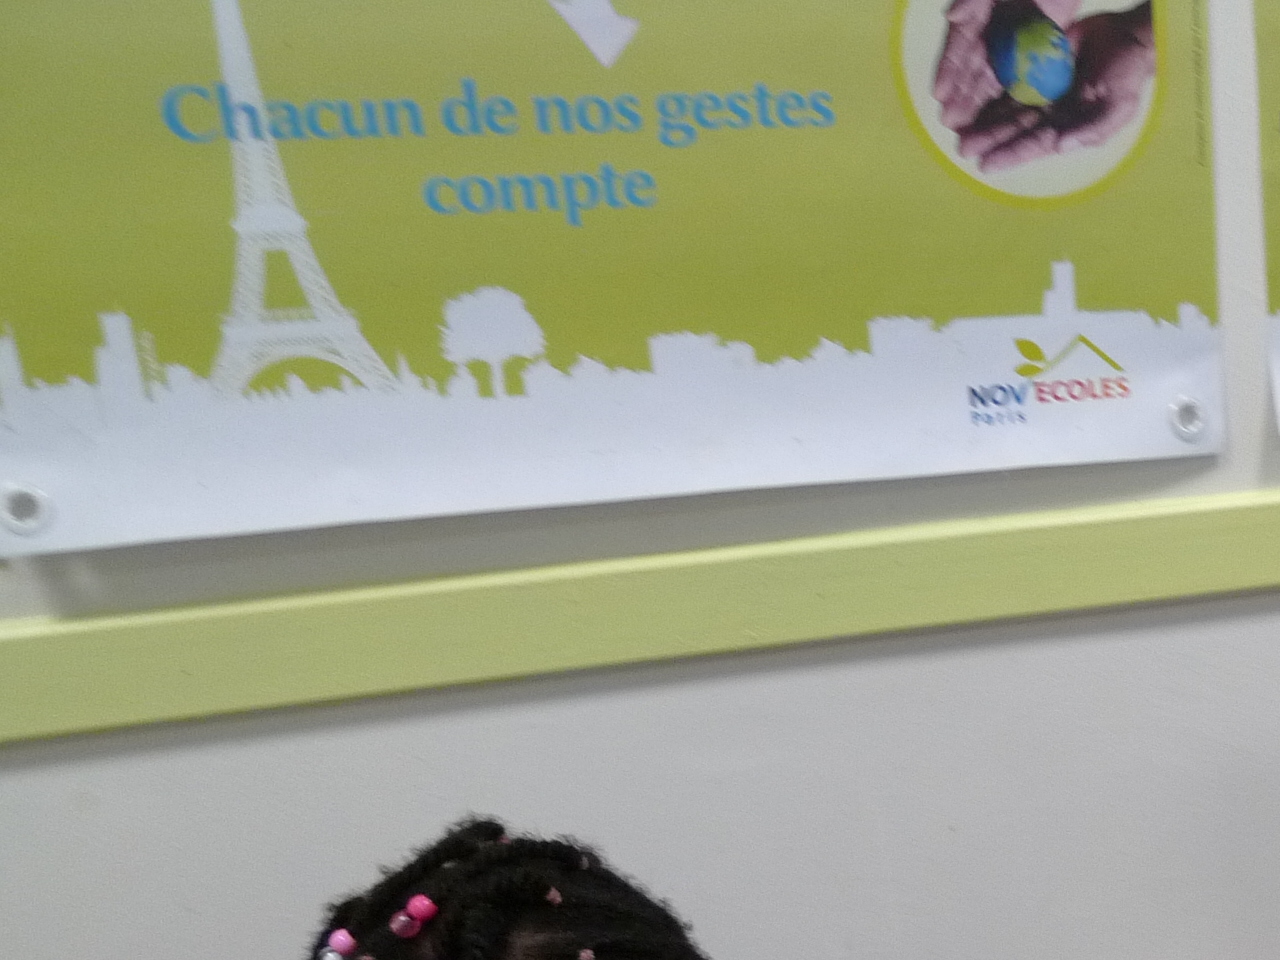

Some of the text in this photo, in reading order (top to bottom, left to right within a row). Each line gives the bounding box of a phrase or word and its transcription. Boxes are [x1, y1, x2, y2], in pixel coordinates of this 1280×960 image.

[159, 76, 837, 148] Chacun de nos gestes
[422, 162, 658, 227] compte
